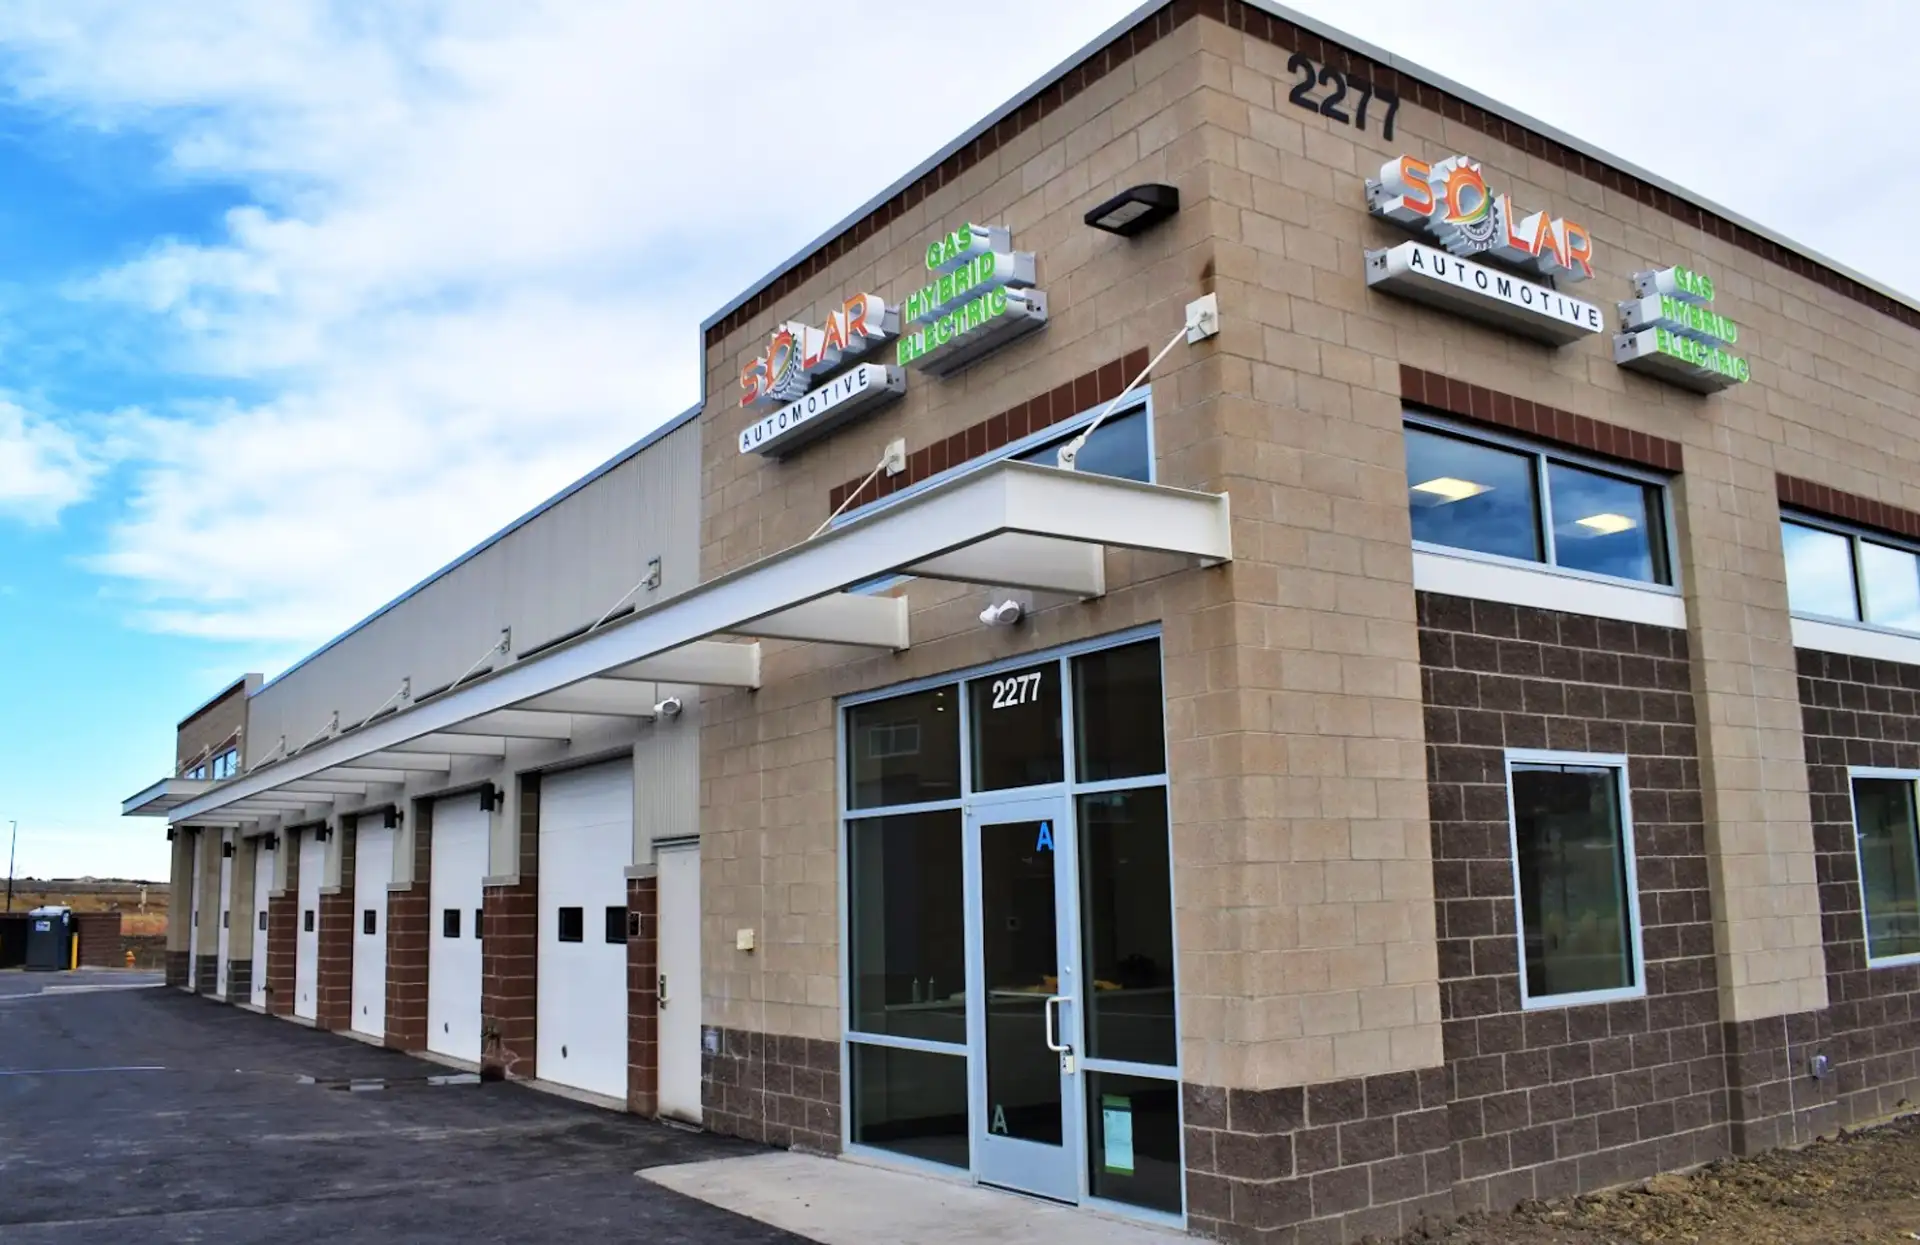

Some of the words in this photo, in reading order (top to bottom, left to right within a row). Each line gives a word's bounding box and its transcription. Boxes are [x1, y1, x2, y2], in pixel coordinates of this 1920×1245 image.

[1287, 52, 1399, 141] 2277
[925, 222, 972, 270] GAS
[1400, 155, 1595, 279] SOLAR
[905, 251, 996, 324] HYBRID
[1411, 248, 1599, 328] AUTOMOTIVE
[1675, 264, 1714, 301] GAS
[739, 292, 868, 408] SOLAR
[897, 285, 1008, 367] ELECTRIC
[1660, 294, 1737, 344] HYBRID
[1656, 327, 1749, 383] ELECTRIC
[742, 367, 868, 448] AUTOMOTIVE
[992, 671, 1041, 709] 2277
[1036, 821, 1054, 852] A
[991, 1104, 1008, 1134] A
